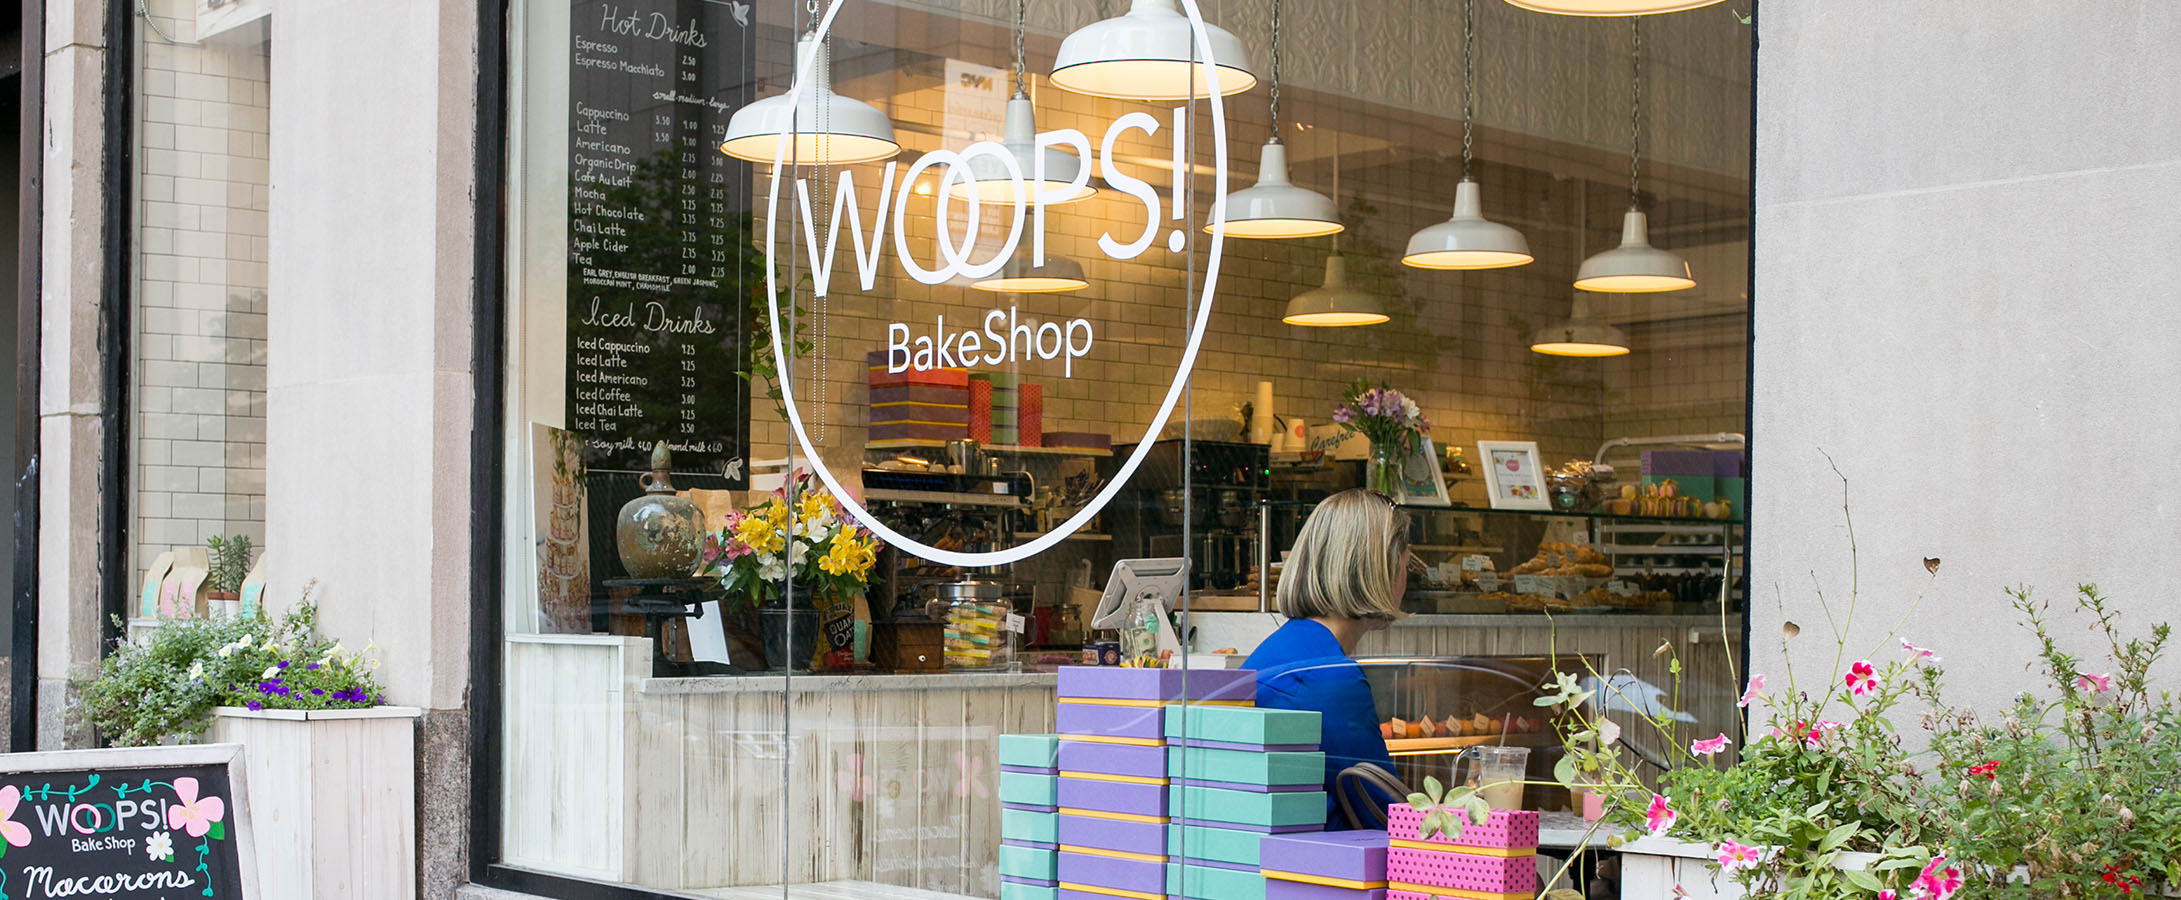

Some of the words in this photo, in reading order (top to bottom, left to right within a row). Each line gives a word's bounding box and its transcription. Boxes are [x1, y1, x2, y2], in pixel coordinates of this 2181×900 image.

[600, 4, 641, 36] Hot
[645, 12, 708, 48] Drinks
[576, 35, 618, 54] Espresso
[682, 55, 696, 66] 2.50
[575, 52, 617, 72] Espresso
[620, 60, 664, 77] Macchiato
[576, 101, 630, 122] Cappuccino
[576, 120, 607, 136] Latte
[576, 138, 630, 154] Americano
[575, 154, 614, 172] Organic
[614, 156, 636, 175] Drip
[682, 168, 696, 180] 2.00
[575, 170, 596, 182] Cafe
[599, 173, 611, 185] Au
[612, 175, 632, 188] Lait
[574, 186, 606, 201] Mocha
[796, 106, 1186, 297] WOOPS!
[574, 203, 592, 216] Hot
[595, 204, 645, 221] Chocolate
[574, 219, 596, 233] Chai
[598, 220, 626, 237] Latte
[682, 230, 696, 242] 3.75
[573, 237, 599, 252] Apple
[603, 239, 629, 253] Cider
[573, 252, 592, 265] Tea
[682, 264, 696, 275] 2.00
[584, 268, 597, 277] EARL
[614, 270, 637, 280] ENGLISH
[584, 277, 615, 286] MOROCCAN
[582, 296, 635, 327] Iced
[644, 302, 716, 334] Drinks
[577, 336, 596, 350] Iced
[599, 338, 650, 354] Cappuccino
[577, 353, 597, 366] Iced
[599, 354, 627, 368] Latte
[576, 370, 597, 382] Iced
[599, 372, 648, 386] Americano
[576, 387, 597, 400] Iced
[599, 388, 631, 402] Coffee
[682, 394, 695, 405] 3.00
[576, 403, 595, 415] Iced
[597, 404, 616, 416] Chai
[618, 404, 643, 417] Latte
[576, 418, 595, 430] Iced
[599, 418, 616, 431] Tea
[35, 798, 169, 836] WOOPS!
[23, 866, 195, 899] Macarons
